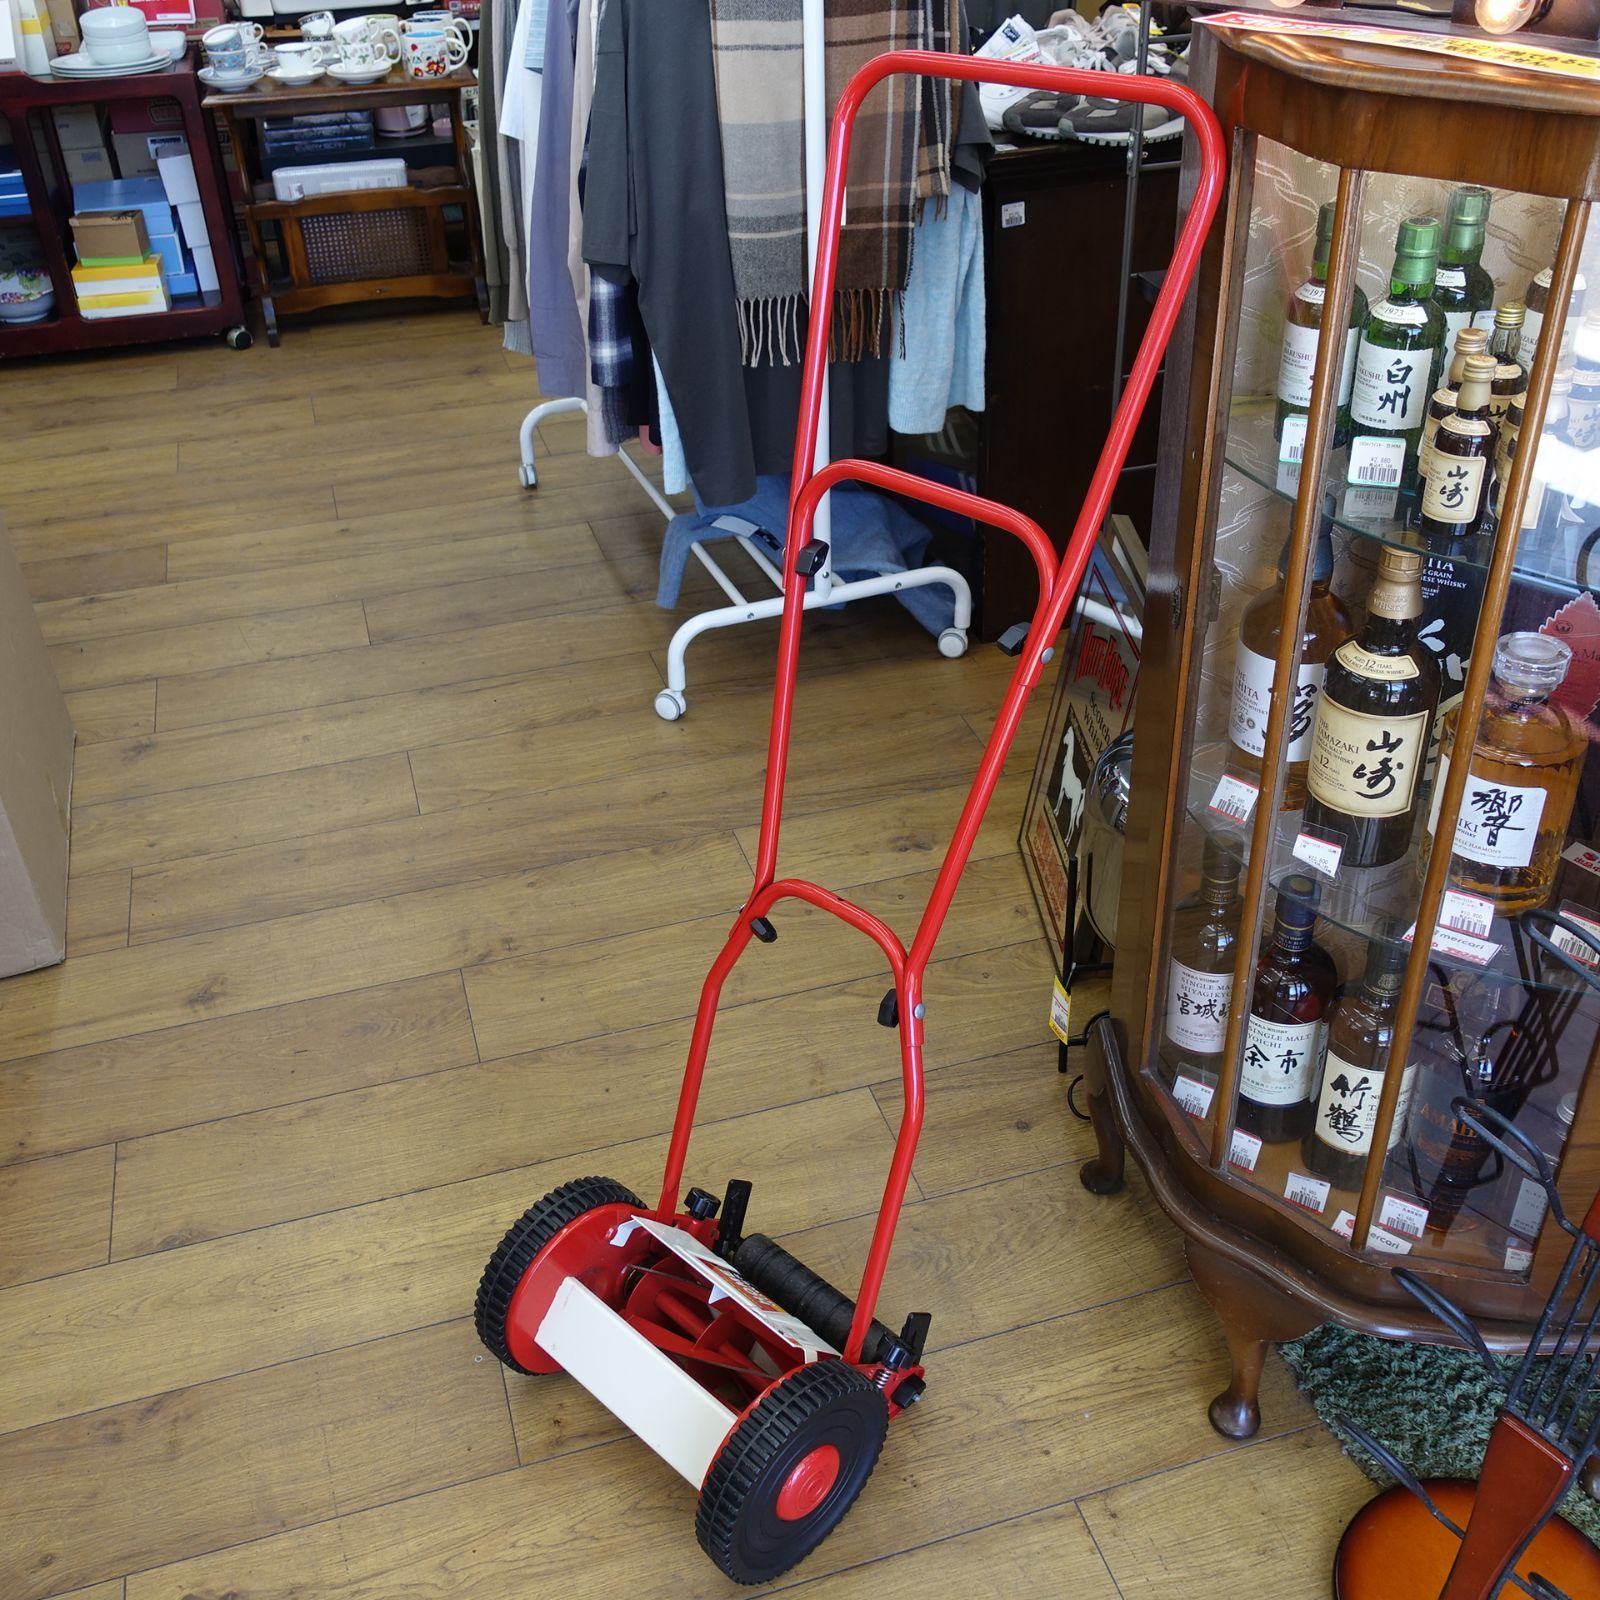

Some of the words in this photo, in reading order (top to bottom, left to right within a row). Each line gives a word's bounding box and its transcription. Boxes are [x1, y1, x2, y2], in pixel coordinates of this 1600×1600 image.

[1384, 307, 1404, 316] 1973
[1377, 358, 1413, 418] 白州
[1440, 465, 1470, 508] 山崎
[1427, 569, 1453, 580] GRAIN
[1437, 578, 1468, 590] WHISKY
[1365, 659, 1376, 669] 12
[1318, 726, 1359, 754] YAMAZAKI
[1320, 754, 1330, 769] 12
[1352, 730, 1405, 800] 山崎
[1458, 818, 1479, 834] IKI
[1471, 789, 1526, 847] 響
[1440, 933, 1485, 950] mercari
[1181, 976, 1214, 991] SINGLE
[1248, 1025, 1283, 1041] SINGLE
[1285, 1033, 1312, 1042] MALT
[1248, 1033, 1282, 1049] YOICHI
[1244, 1043, 1305, 1075] 余市
[1324, 1073, 1371, 1144] 竹鶴
[1370, 1231, 1400, 1249] ercari
